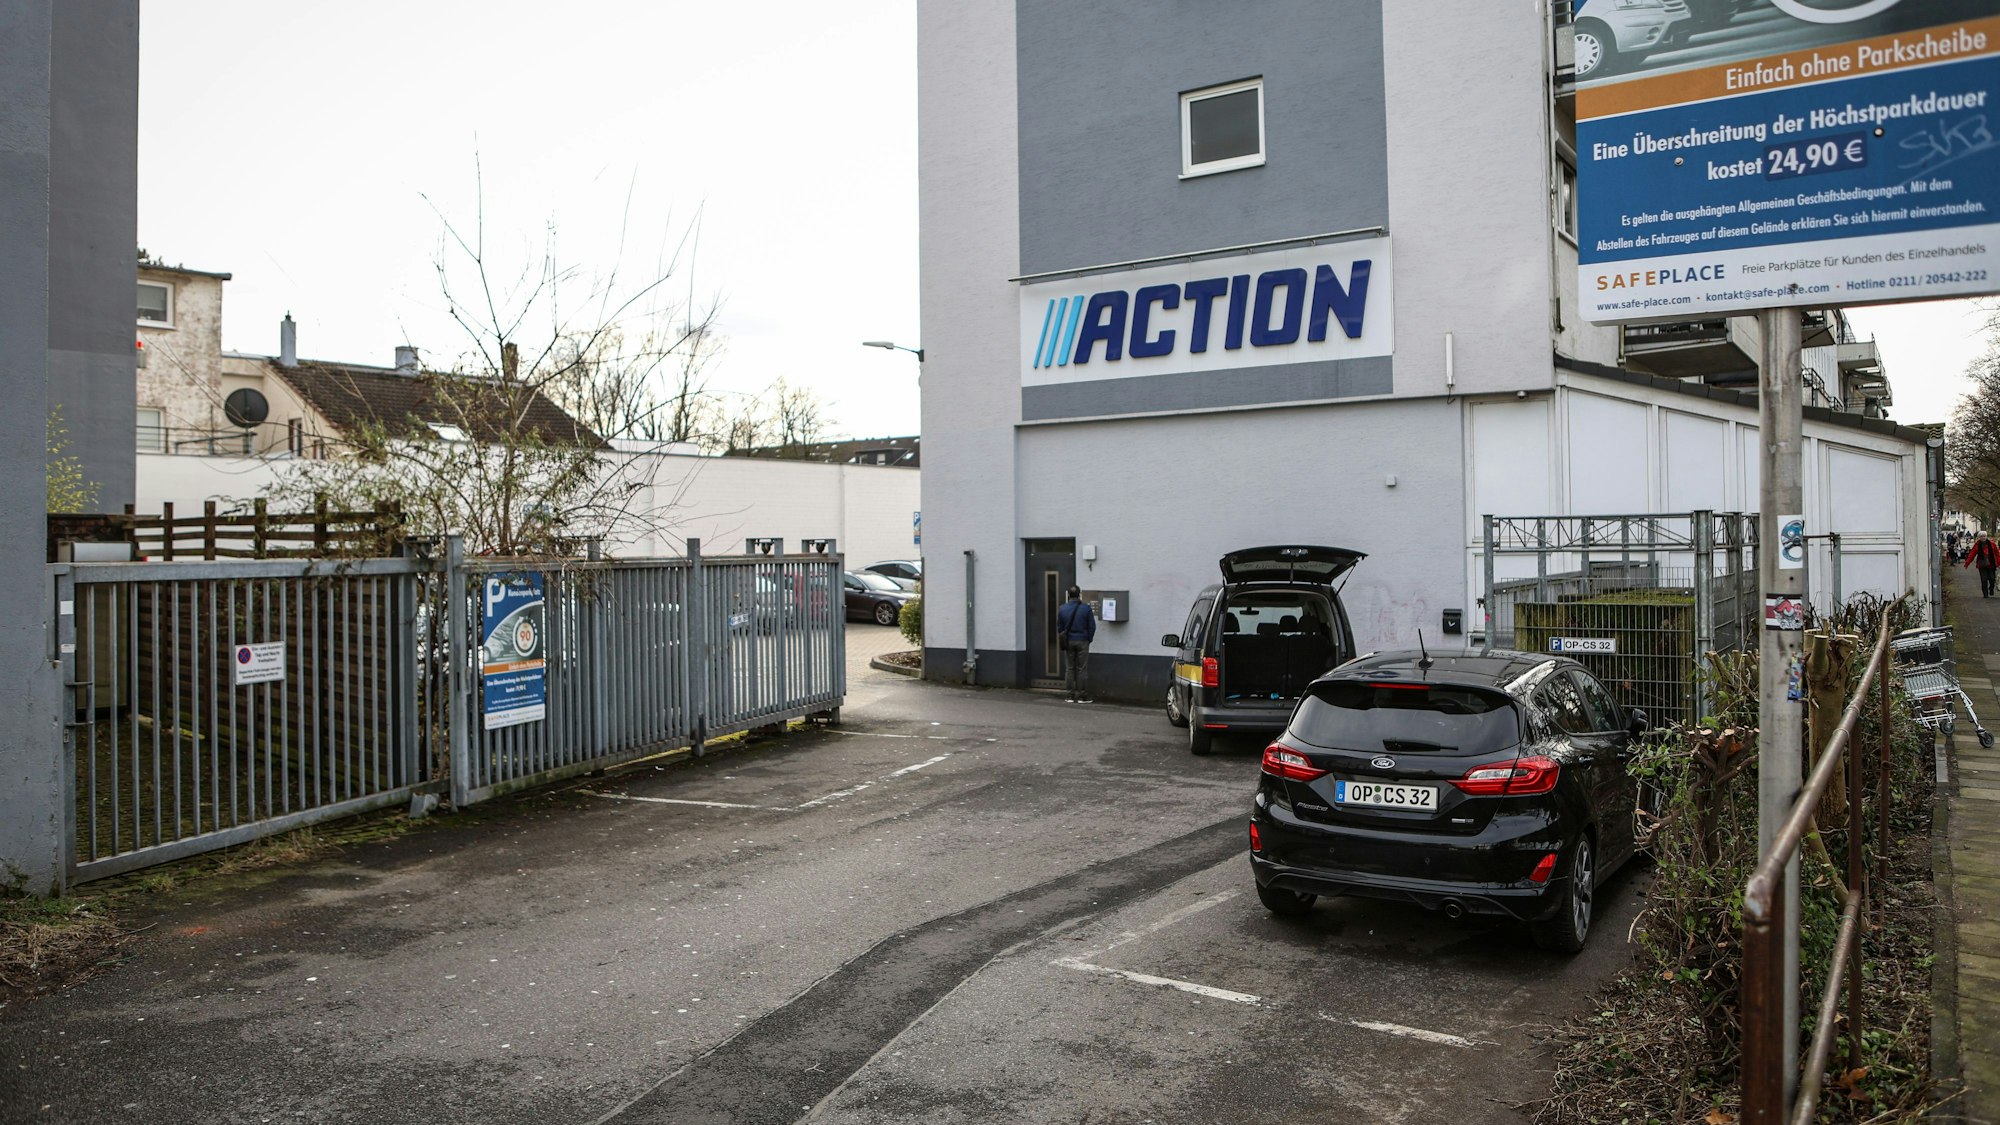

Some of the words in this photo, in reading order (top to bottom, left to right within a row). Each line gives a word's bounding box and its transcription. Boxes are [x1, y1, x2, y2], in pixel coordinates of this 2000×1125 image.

[1725, 58, 1794, 90] Einfach
[1801, 53, 1851, 78] ohne
[1857, 27, 1987, 69] Parkscheibe
[1593, 141, 1628, 161] Eine
[1633, 122, 1767, 155] Überschreitung
[1772, 114, 1804, 135] der
[1810, 91, 1987, 130] Höchstparkdauer
[1707, 157, 1763, 181] kostet
[1768, 141, 1838, 175] 24,90
[1843, 139, 1864, 163] €
[1596, 237, 1634, 252] Abstellen
[1635, 235, 1650, 247] des
[1651, 232, 1700, 246] Fahrzeuges
[1701, 227, 1716, 240] auf
[1717, 225, 1749, 239] diesem
[1751, 220, 1789, 235] Gelände
[1791, 216, 1831, 231] erklären
[1833, 213, 1849, 226] Sie
[1850, 210, 1869, 225] sich
[1871, 207, 1909, 222] hiermit
[1910, 200, 1986, 219] einverstanden.
[1621, 214, 1631, 226] Es
[1632, 212, 1658, 227] gelten
[1660, 210, 1674, 221] die
[1675, 205, 1736, 220] ausgehängten
[1738, 197, 1795, 213] Allgemeinen
[1797, 184, 1908, 206] Geschäftsbedingungen.
[1910, 180, 1927, 193] Mit
[1929, 178, 1952, 191] dem
[1596, 264, 1726, 291] SAFEPLACE
[1742, 264, 1766, 274] Freie
[1768, 258, 1821, 272] Parkplätze
[1824, 257, 1839, 267] für
[1842, 253, 1882, 265] Kunden
[1885, 251, 1905, 262] des
[1908, 243, 1987, 260] Einzelhandels
[1597, 296, 1692, 311] www.safe-place.com
[1846, 279, 1886, 291] Hotline
[1889, 276, 1916, 288] 0211
[1925, 270, 1988, 285] 20542-222
[1073, 259, 1373, 365] ACTION
[520, 631, 531, 641] 90
[1565, 640, 1597, 650] OP-CS
[1599, 641, 1611, 650] 32
[1352, 785, 1373, 802] OP
[1384, 787, 1406, 804] CS
[1409, 788, 1431, 806] 32
